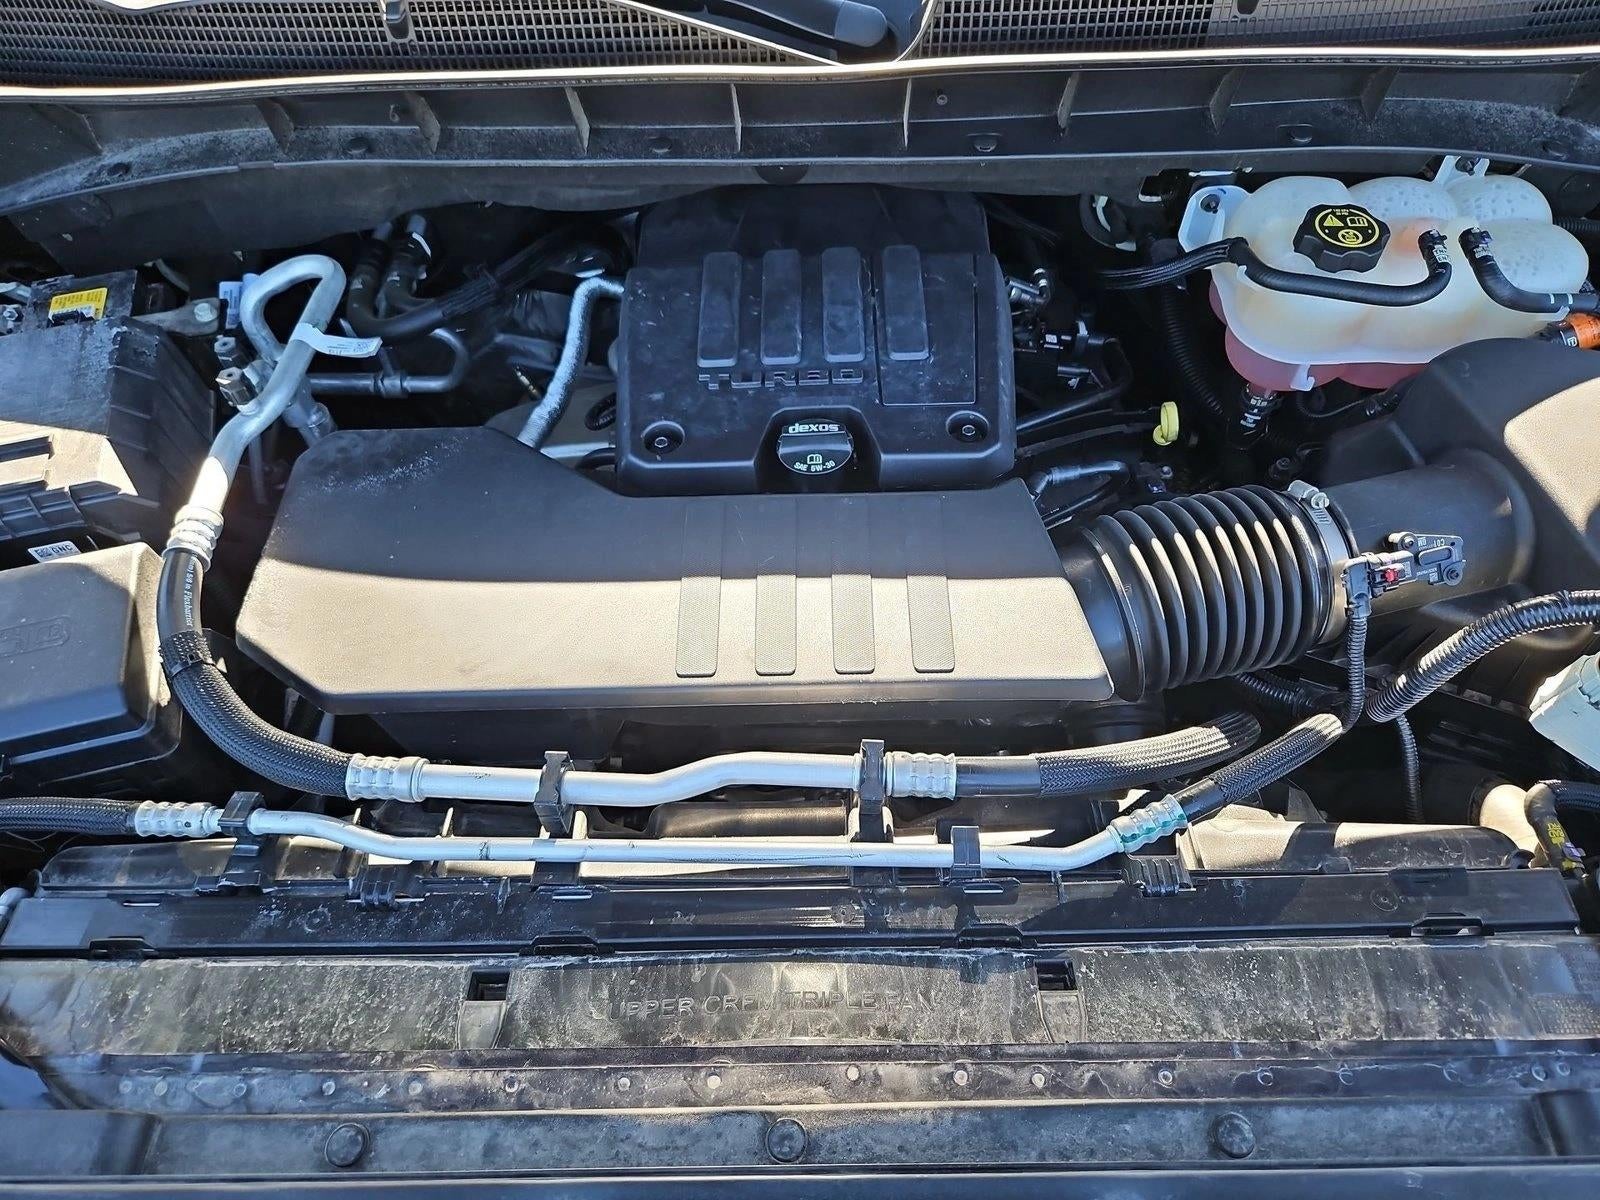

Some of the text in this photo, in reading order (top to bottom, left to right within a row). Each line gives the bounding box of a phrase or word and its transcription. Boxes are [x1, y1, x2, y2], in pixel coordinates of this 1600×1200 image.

[698, 367, 863, 390] TURBO
[788, 423, 839, 434] dexos
[793, 460, 836, 473] SAE 5W-30
[51, 544, 73, 554] GMC
[608, 997, 695, 1021] UPPER
[785, 990, 877, 1011] TRIPLE
